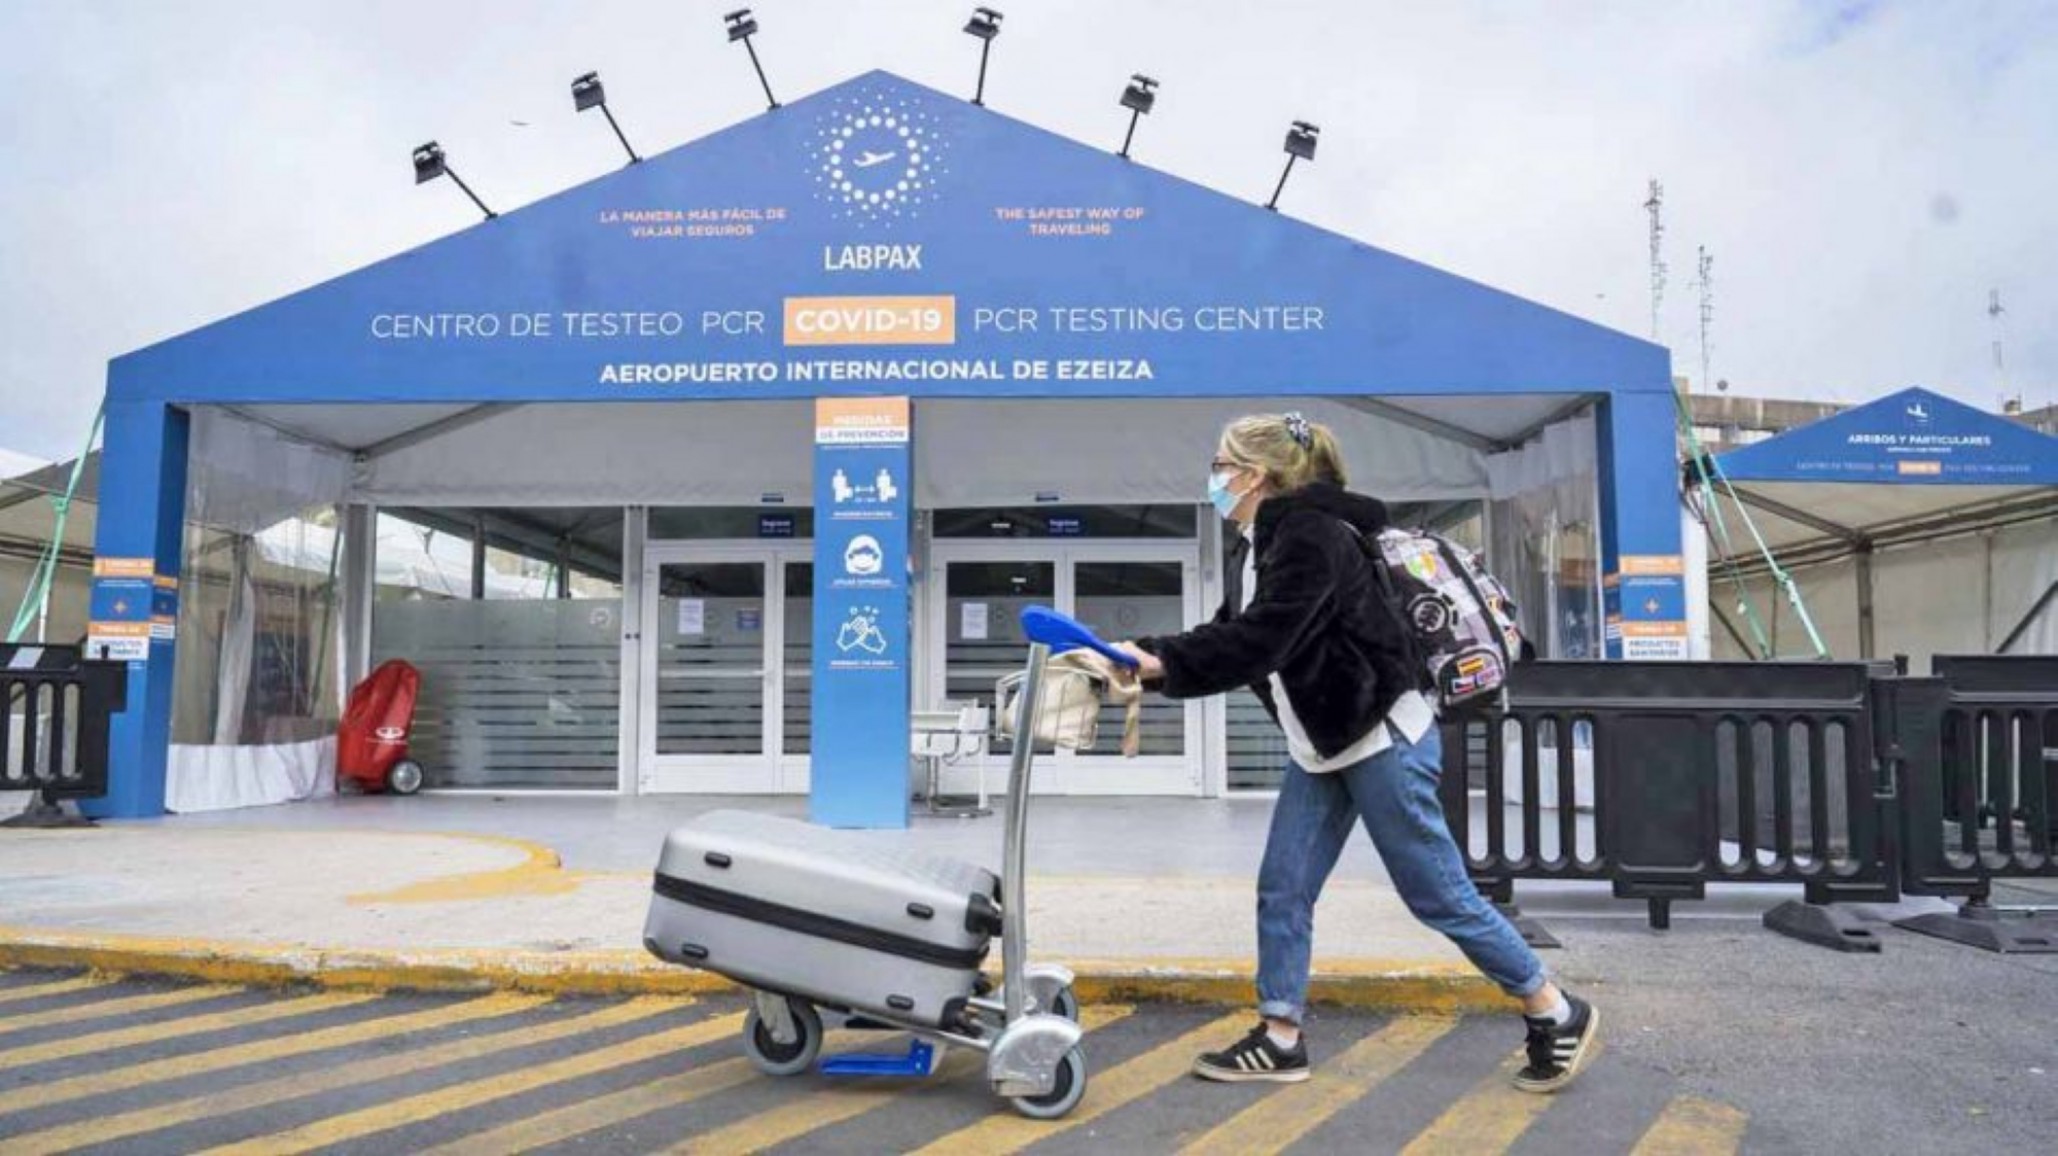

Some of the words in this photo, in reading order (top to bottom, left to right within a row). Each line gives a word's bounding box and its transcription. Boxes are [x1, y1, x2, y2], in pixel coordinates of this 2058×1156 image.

[601, 211, 619, 223] LA
[622, 210, 684, 223] MANERA
[766, 207, 786, 220] DE
[995, 207, 1025, 219] THE
[1028, 207, 1083, 219] SAFEST
[1086, 207, 1120, 219] WAY
[1123, 207, 1145, 219] OF
[631, 225, 684, 238] VIAJAR
[687, 223, 755, 237] SEGUROS
[1030, 222, 1112, 236] TRAVELING
[824, 244, 922, 272] LABPAX
[371, 313, 501, 338] CENTRO
[510, 312, 552, 337] DE
[562, 311, 683, 337] TESTEO
[702, 310, 765, 335] PCR
[795, 308, 942, 334] COVID-19
[973, 307, 1038, 332] PCR
[1049, 306, 1184, 332] TESTING
[1195, 306, 1324, 331] CENTER
[600, 361, 778, 384] AEROPUERTO
[786, 359, 1004, 382] INTERNACIONAL
[1012, 359, 1049, 381] DE
[1056, 359, 1154, 380] EZEIZA
[1847, 434, 1896, 445] ARRIBOS
[1899, 435, 1907, 444] Y
[1909, 434, 1991, 446] PARTICULARES
